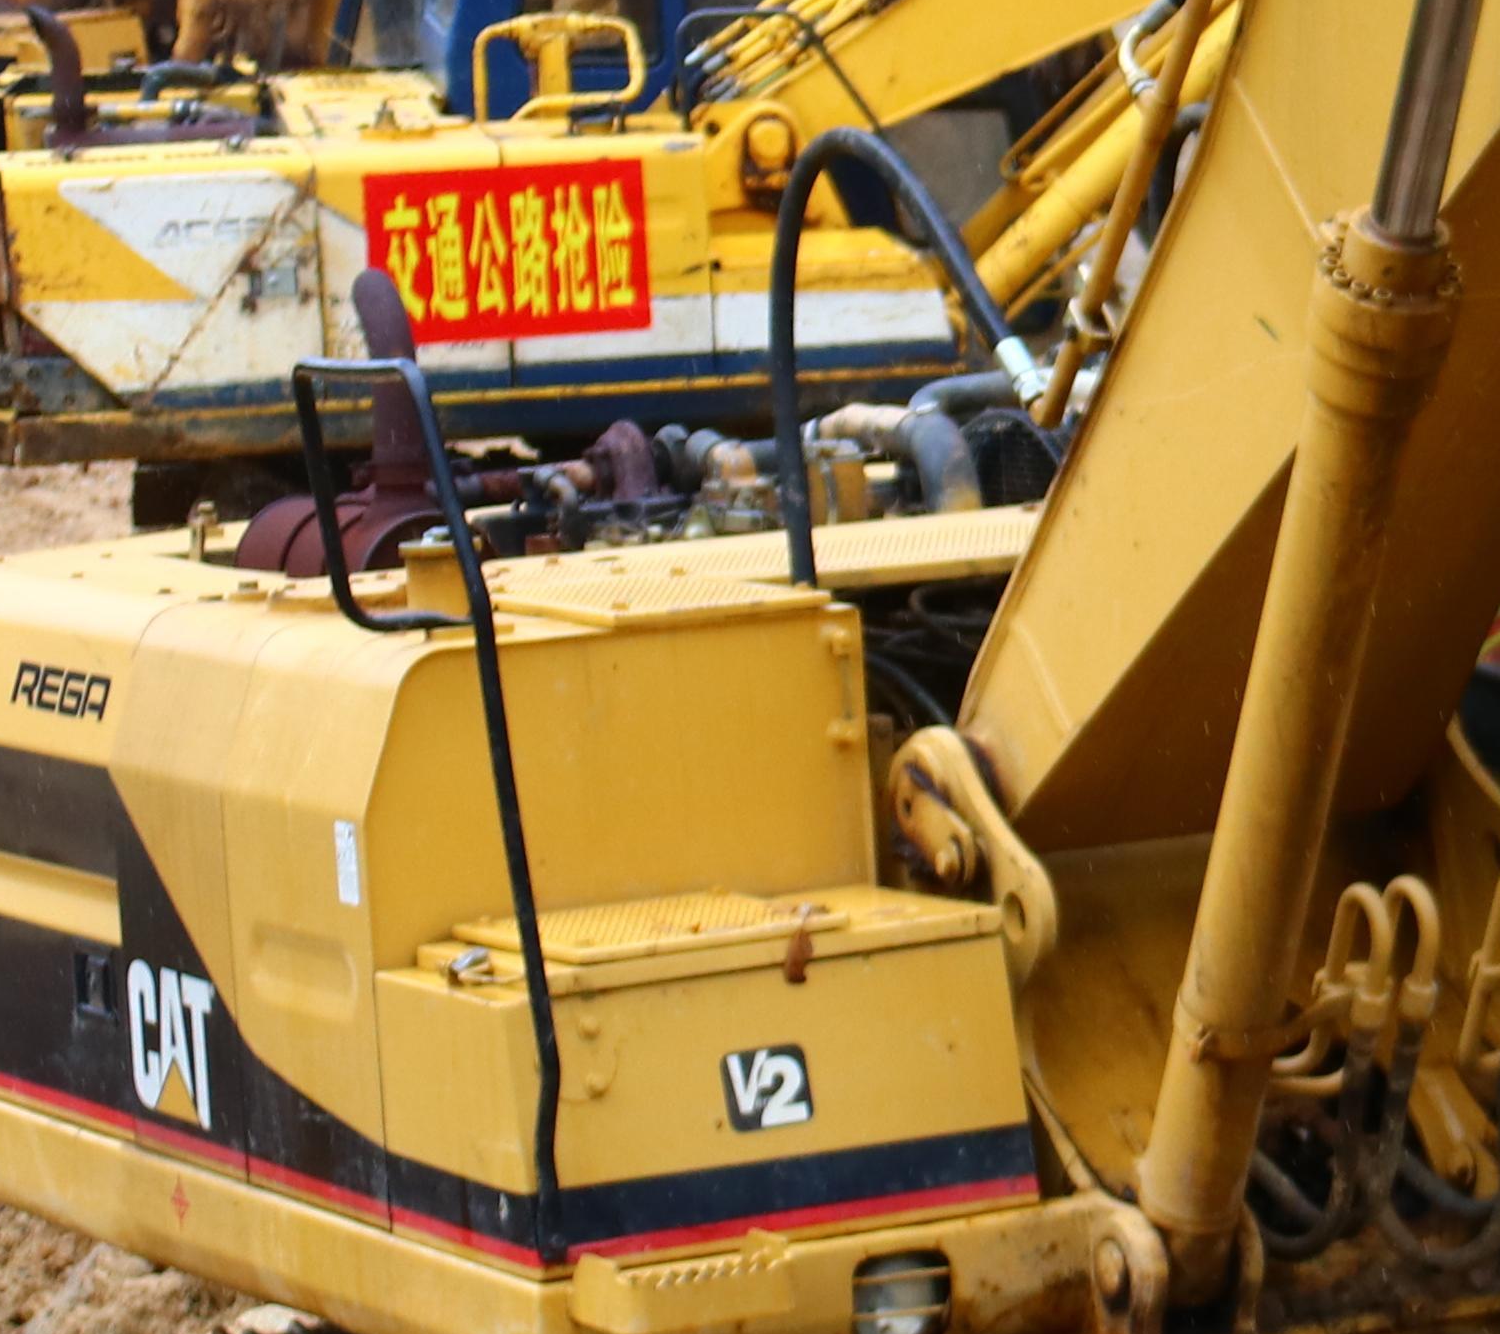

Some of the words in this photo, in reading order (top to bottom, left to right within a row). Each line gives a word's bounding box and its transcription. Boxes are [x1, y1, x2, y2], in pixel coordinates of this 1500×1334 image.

[383, 183, 636, 322] 交通公路抢险
[11, 661, 110, 720] REGA
[127, 957, 214, 1130] CAT
